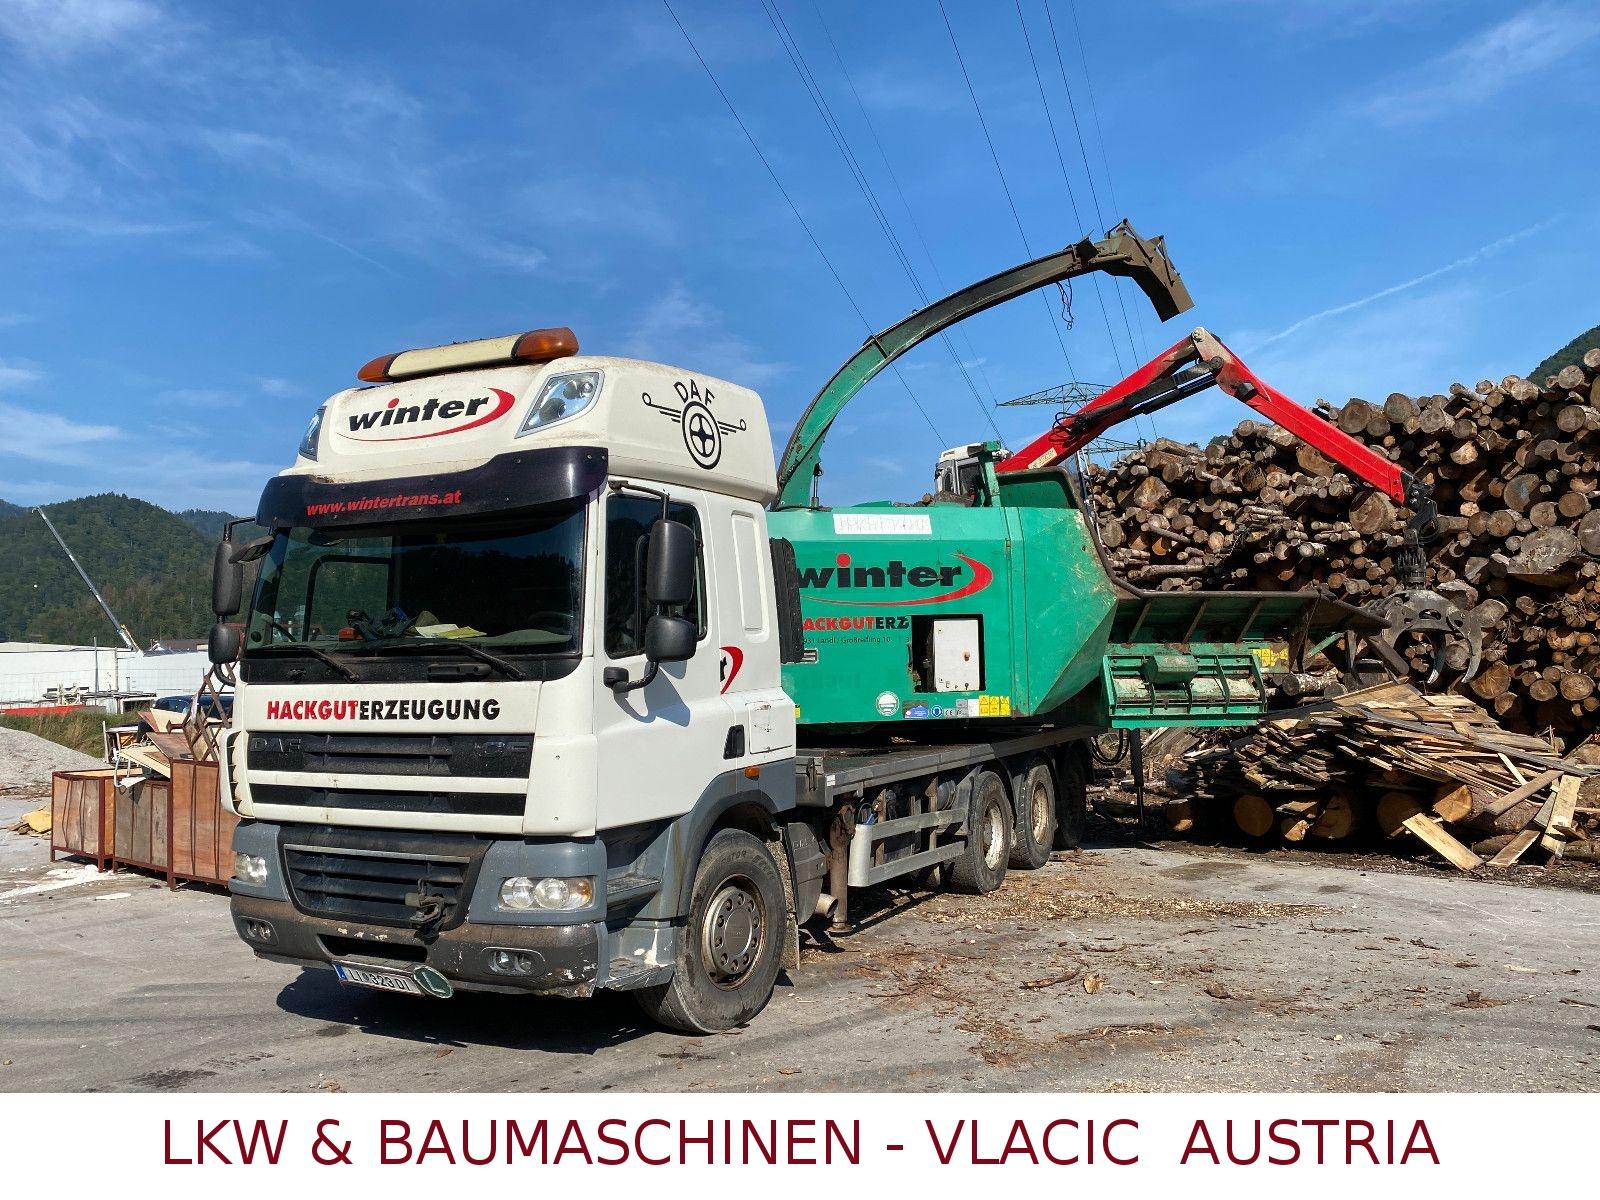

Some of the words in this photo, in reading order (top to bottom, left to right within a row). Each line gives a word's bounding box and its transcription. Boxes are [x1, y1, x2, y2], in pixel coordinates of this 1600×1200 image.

[673, 379, 716, 406] DAF
[348, 396, 490, 432] winter
[307, 489, 462, 516] www.wintertrans.at
[796, 552, 962, 588] winter
[266, 698, 501, 721] HACKGUTERZEUGUNG
[249, 737, 302, 753] DAF
[369, 973, 395, 988] 323
